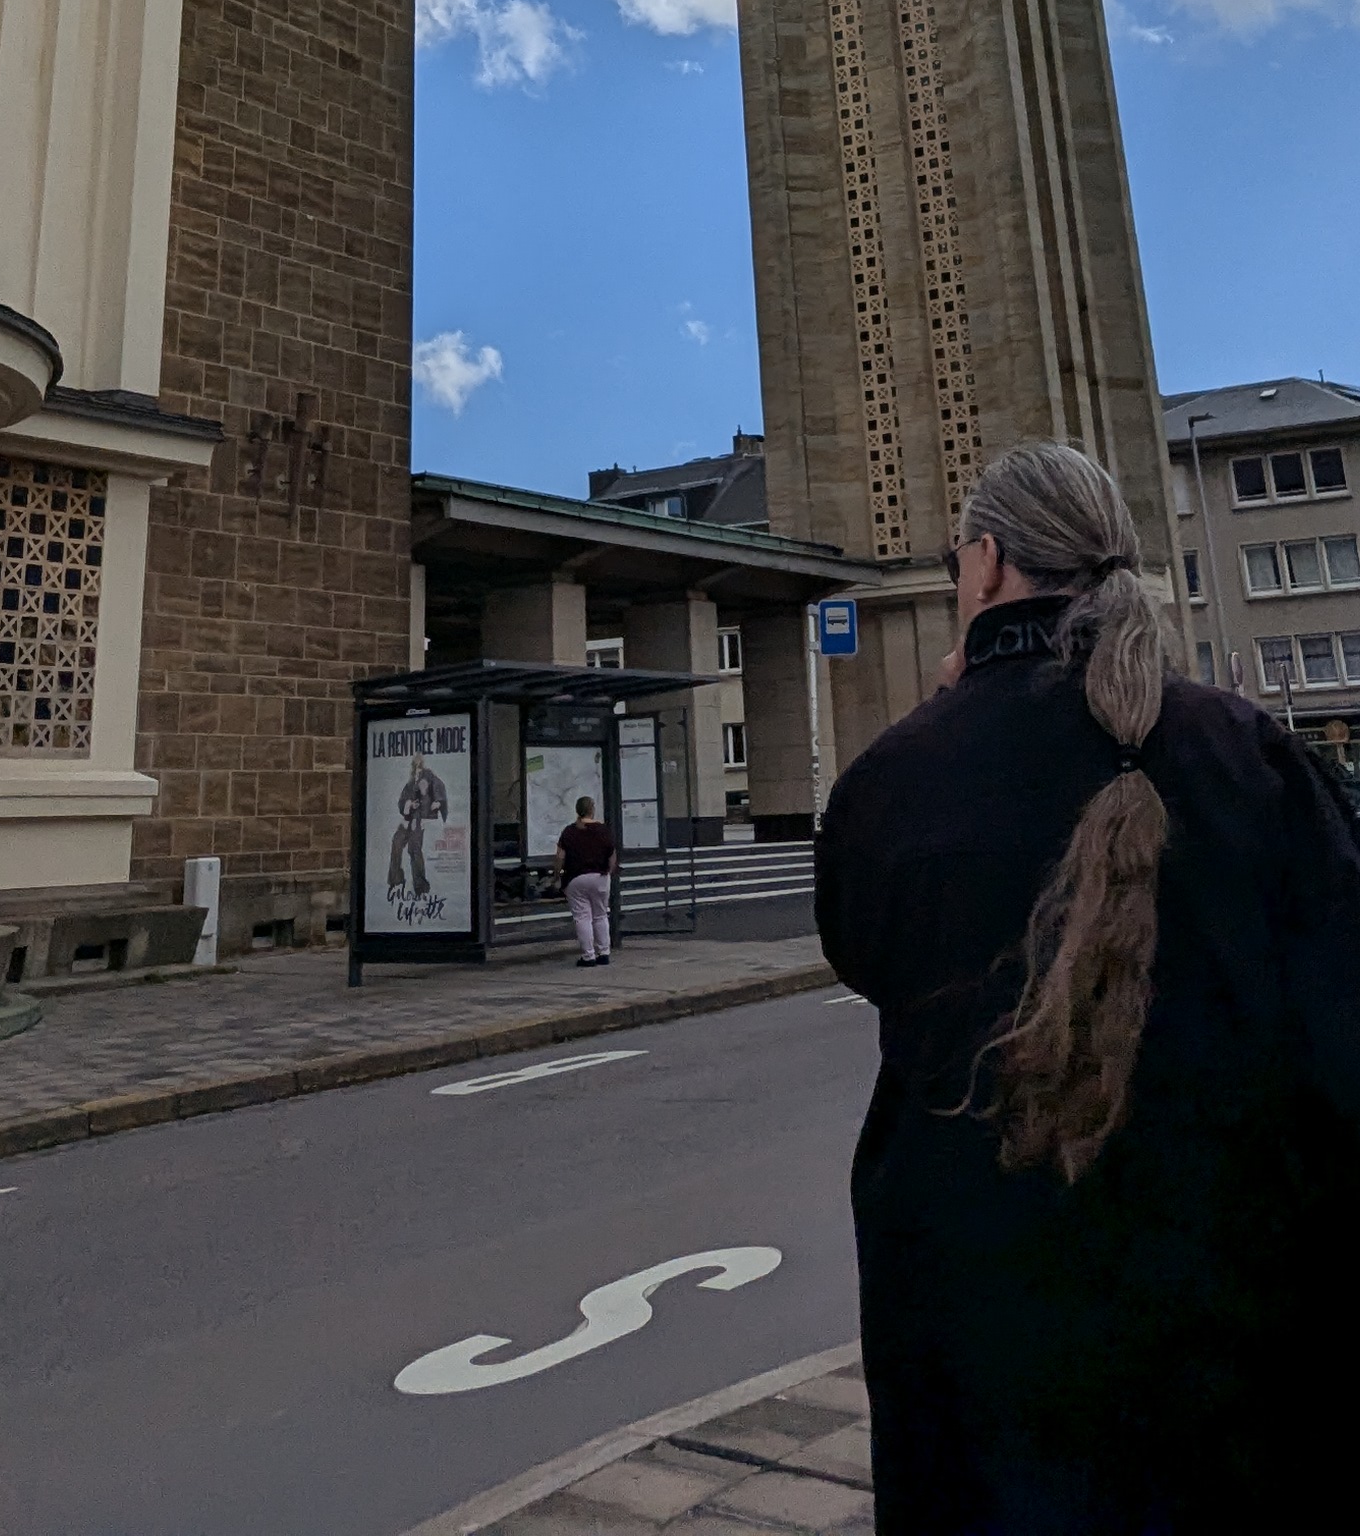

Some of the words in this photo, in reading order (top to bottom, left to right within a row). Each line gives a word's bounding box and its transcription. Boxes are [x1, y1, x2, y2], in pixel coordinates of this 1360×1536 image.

[372, 731, 386, 758] LA
[387, 722, 435, 758] RENTRÉE
[435, 726, 467, 754] MODE
